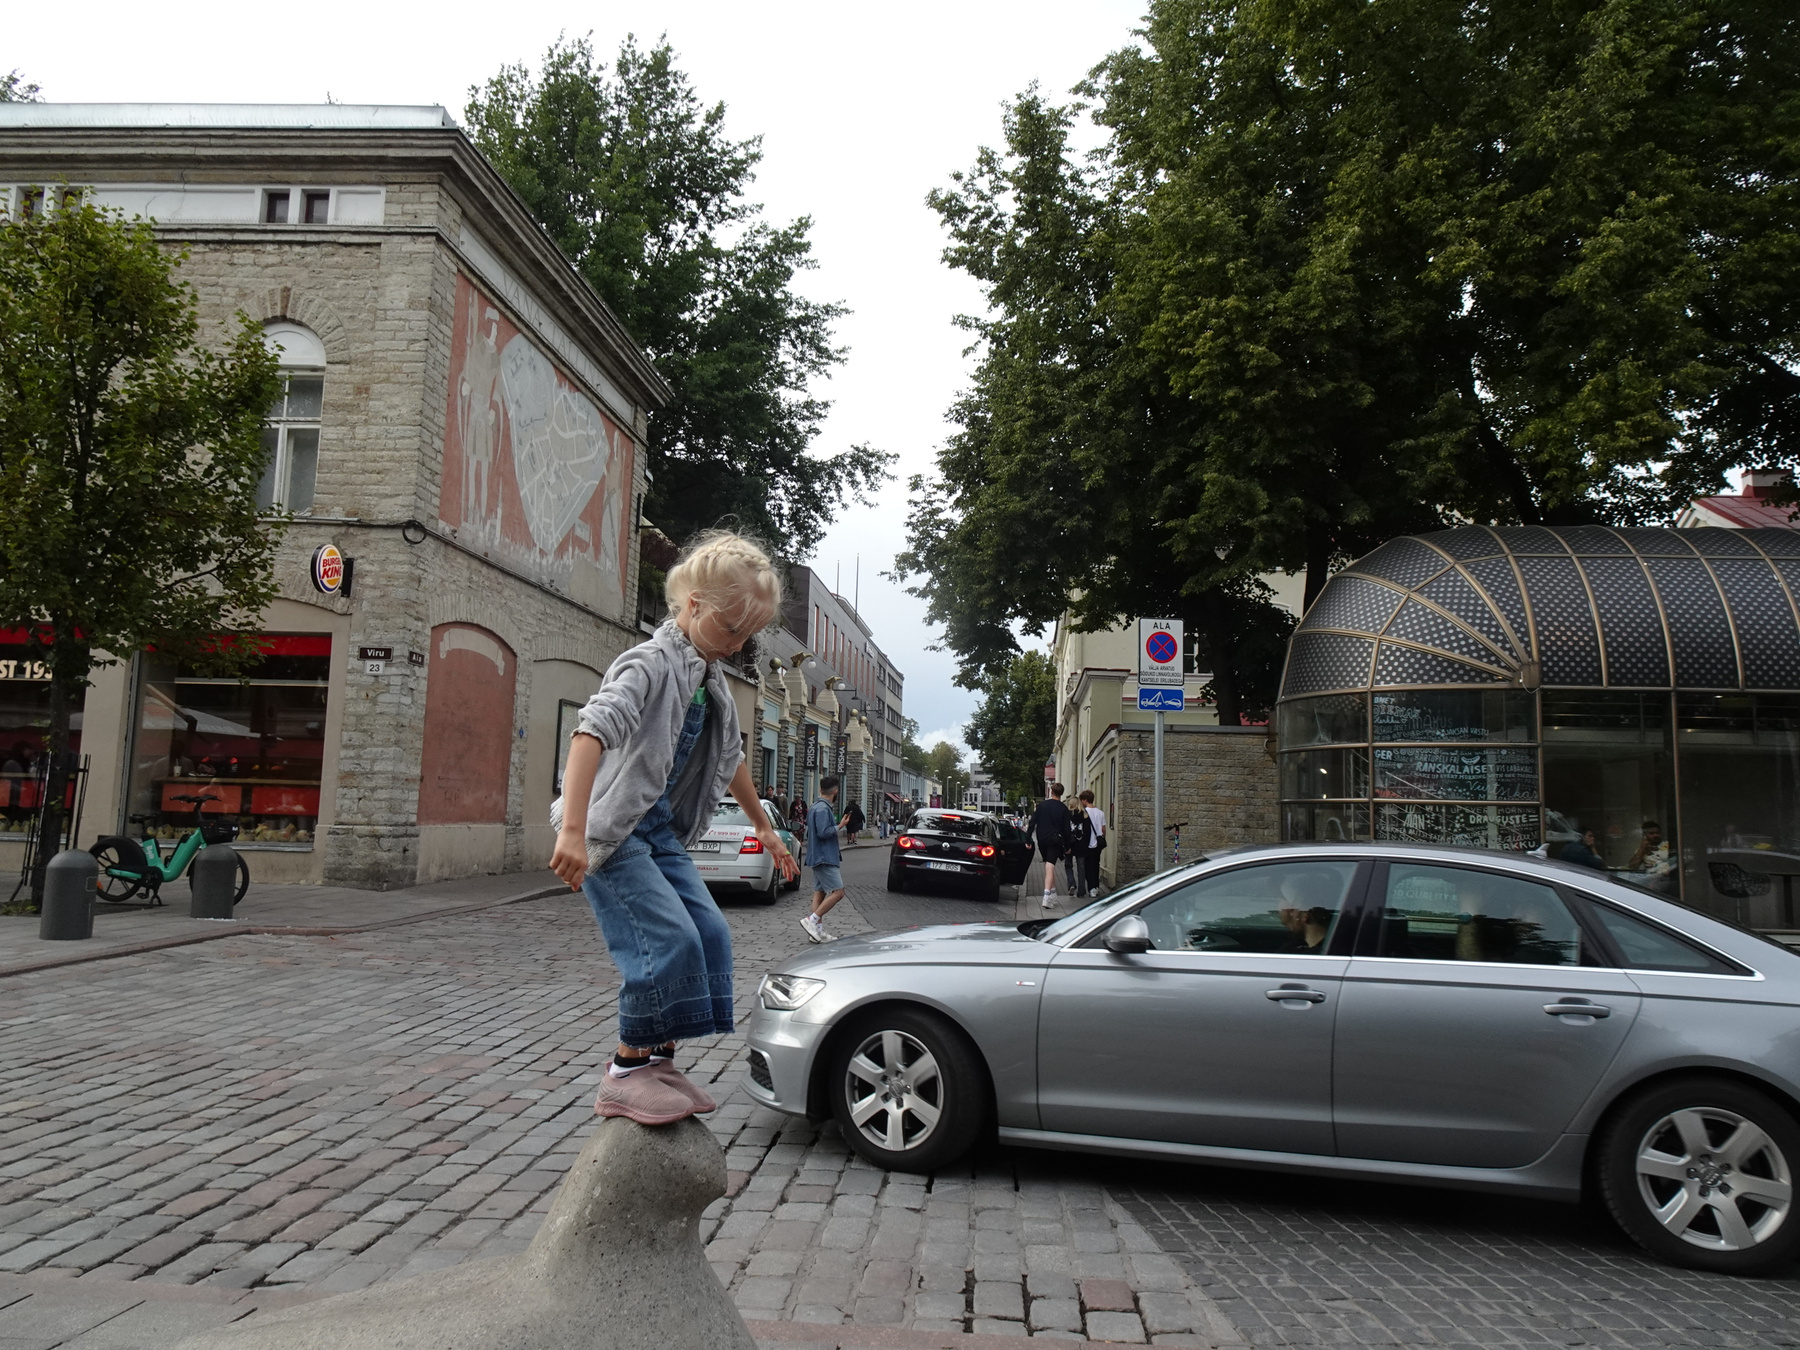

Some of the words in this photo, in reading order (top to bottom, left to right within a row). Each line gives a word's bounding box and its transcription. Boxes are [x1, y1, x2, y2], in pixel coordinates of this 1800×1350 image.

[1152, 622, 1171, 630] ALA
[366, 649, 385, 657] Viru
[369, 664, 380, 672] 23
[806, 735, 815, 767] PRISMA
[837, 745, 845, 773] PRISMA
[1415, 761, 1494, 775] RANSKALAISET
[702, 842, 718, 850] BXP
